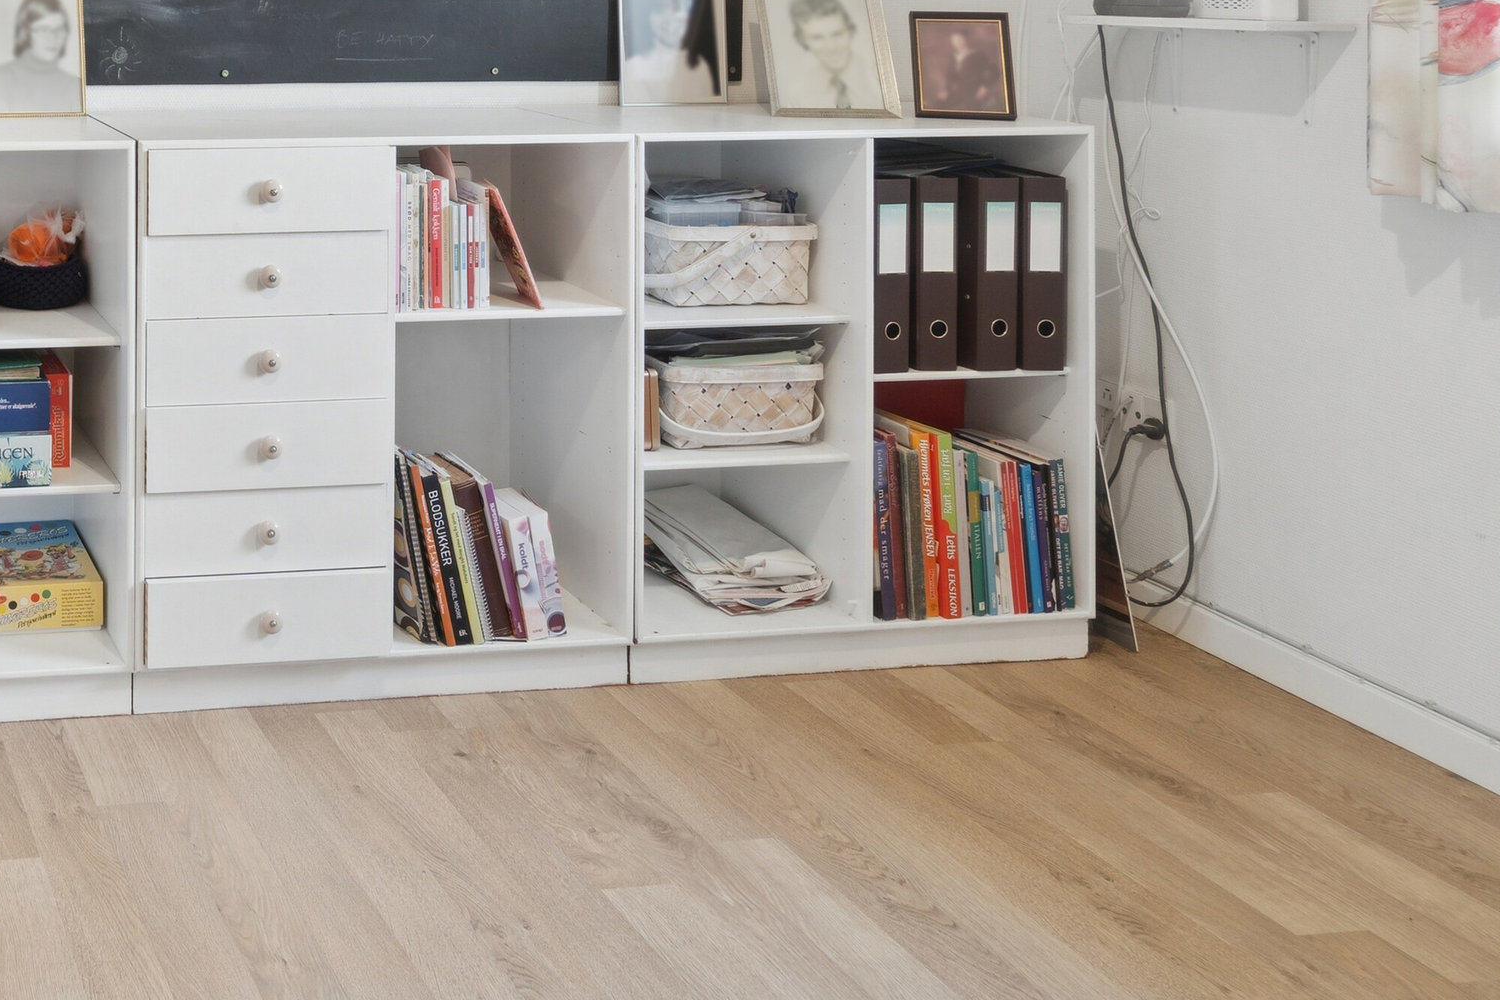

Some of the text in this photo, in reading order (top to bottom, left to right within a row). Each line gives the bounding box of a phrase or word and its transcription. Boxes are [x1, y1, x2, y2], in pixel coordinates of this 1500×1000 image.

[878, 489, 886, 512] mad
[920, 439, 934, 557] Hjemmets Frøken JENSEN
[1056, 463, 1066, 509] JAMIE OLIVER
[427, 490, 452, 566] BLODSUKKER
[488, 502, 500, 534] SUPERNEMT
[880, 517, 888, 535] der
[497, 538, 504, 546] EN
[498, 546, 507, 560] SKÅL
[518, 542, 530, 570] koldt
[880, 540, 890, 580] smager
[974, 524, 982, 560] ITALIEN
[946, 535, 958, 616] Leths LEKSIKON
[448, 577, 462, 619] MICHAEL MOORE
